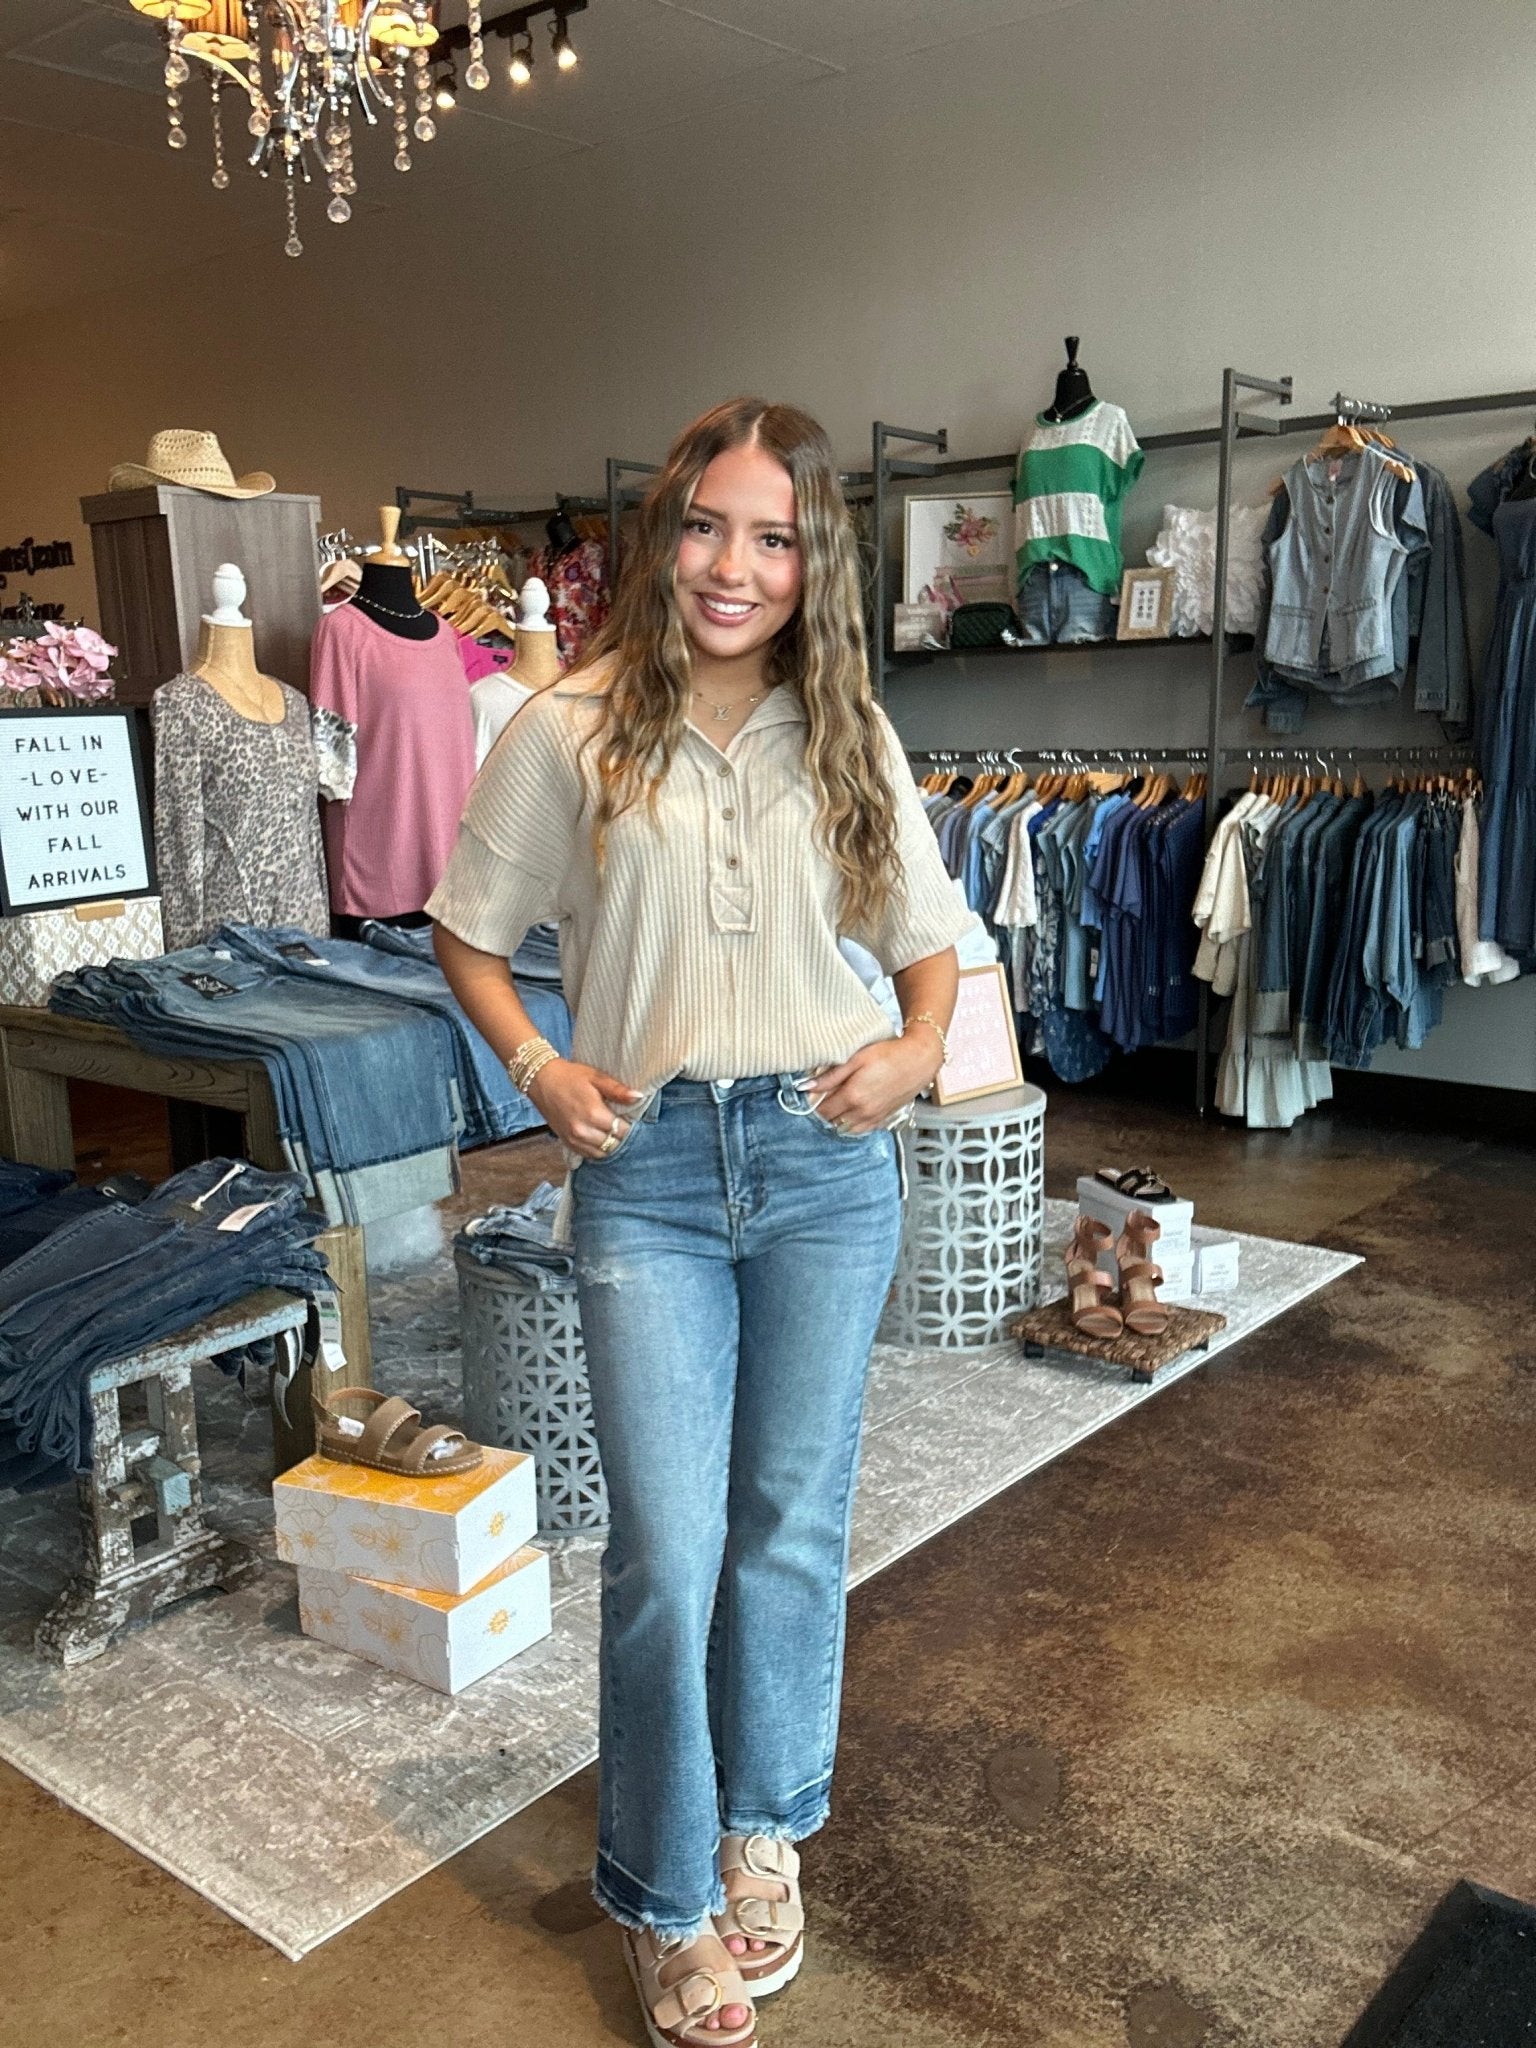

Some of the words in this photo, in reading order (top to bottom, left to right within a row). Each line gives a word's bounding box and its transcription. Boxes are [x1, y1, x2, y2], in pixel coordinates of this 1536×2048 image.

[14, 735, 71, 753] FALL
[82, 734, 103, 751] IN
[16, 803, 70, 821] WITH
[80, 799, 119, 817] OUR
[48, 834, 102, 853] FALL
[28, 864, 127, 890] ARRIVALS
